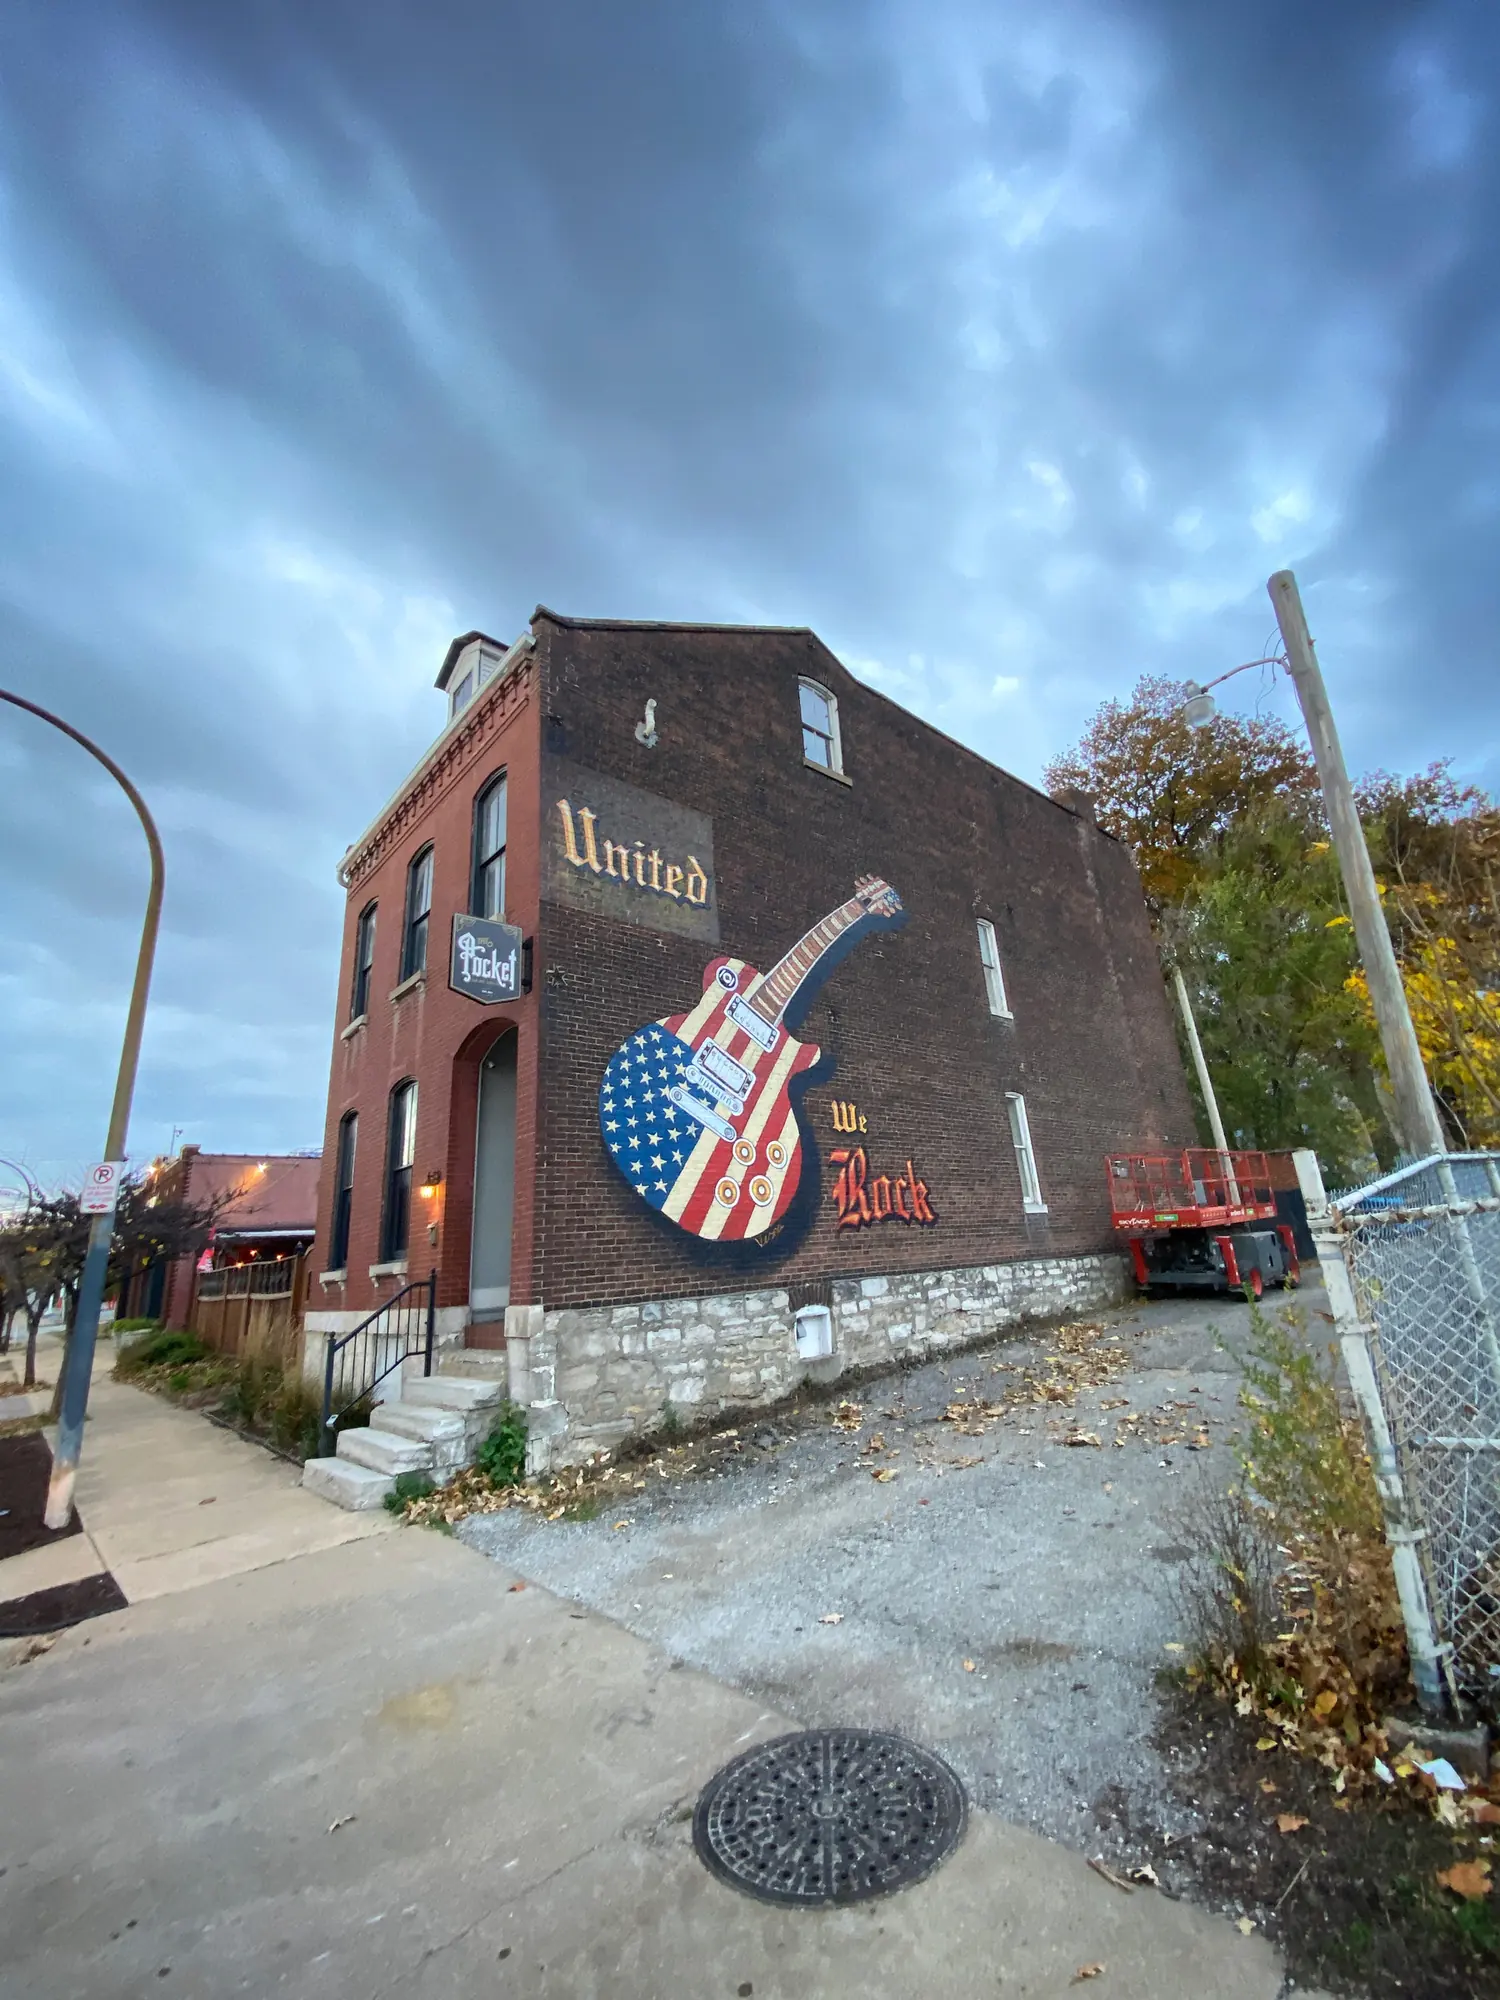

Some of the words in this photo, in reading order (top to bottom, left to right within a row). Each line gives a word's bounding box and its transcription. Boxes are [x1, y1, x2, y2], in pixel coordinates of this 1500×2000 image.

[556, 799, 708, 904] United
[458, 931, 517, 990] Pocket
[831, 1100, 868, 1133] We
[98, 1169, 109, 1181] P
[828, 1145, 935, 1228] Rock
